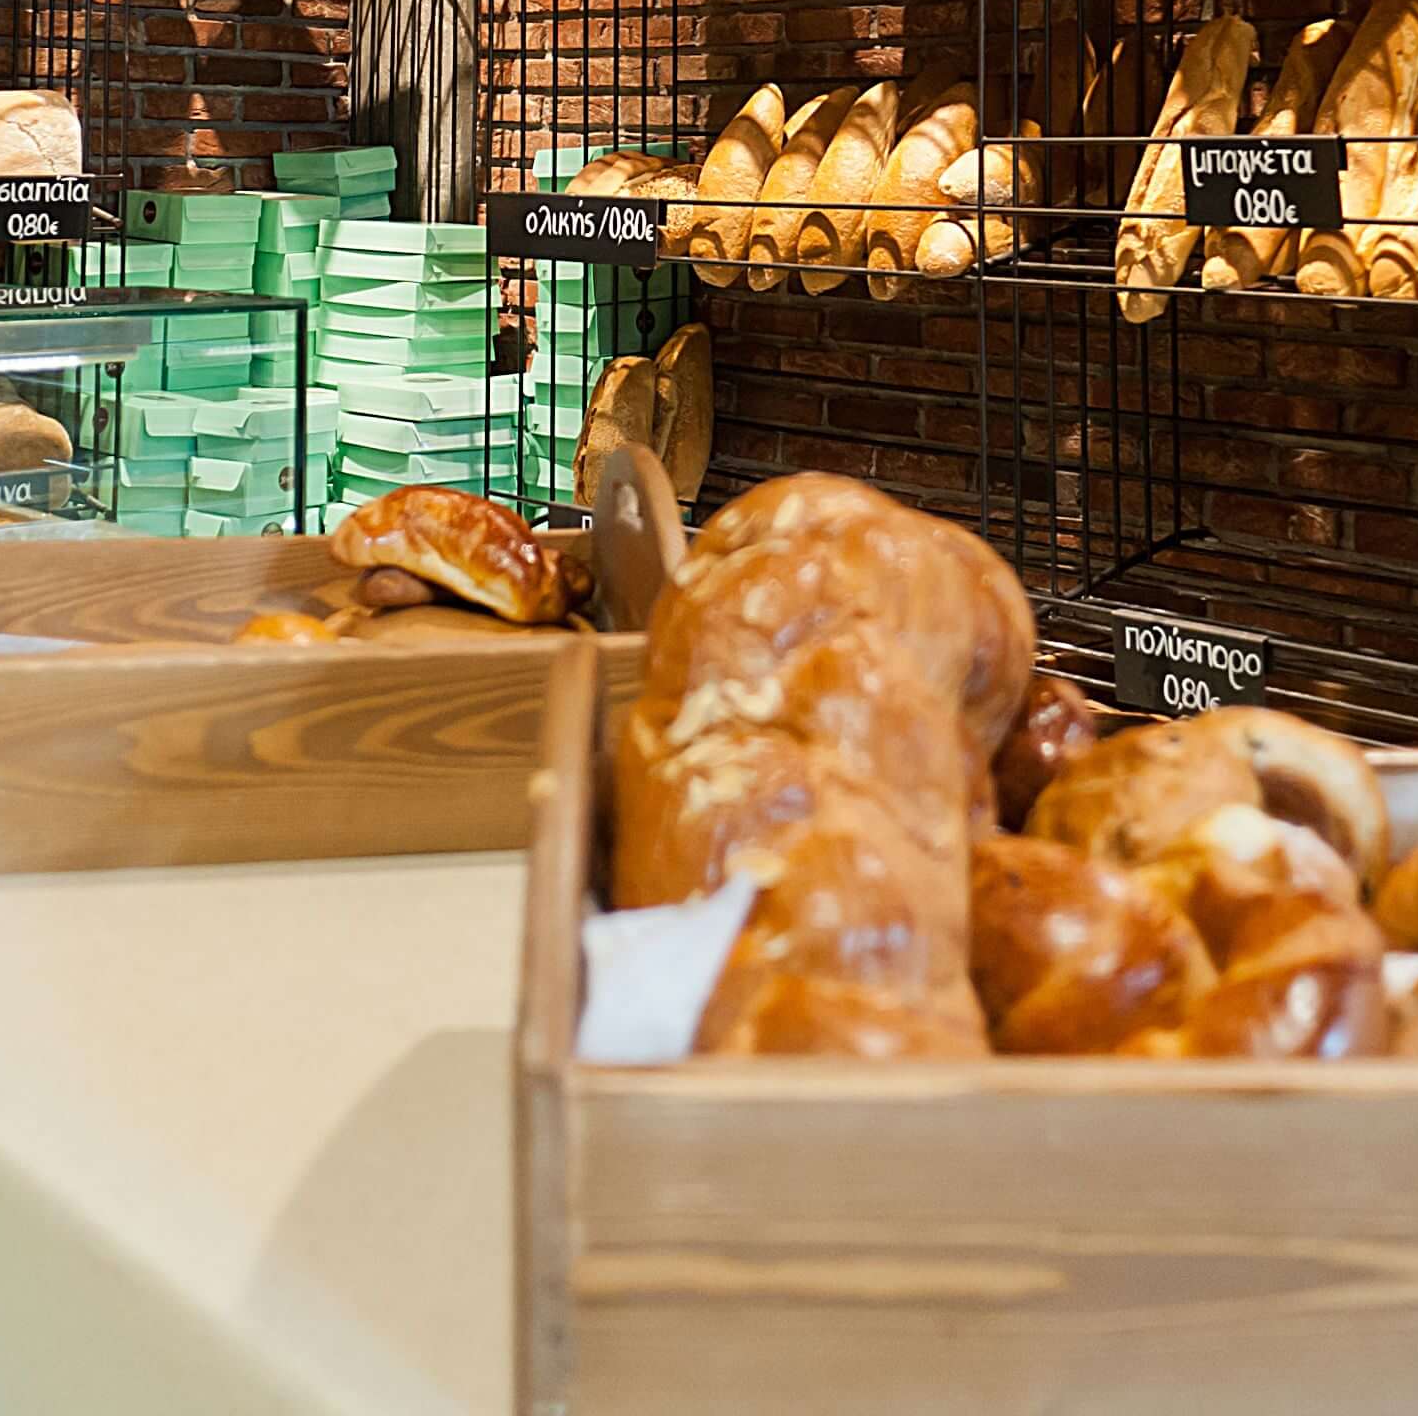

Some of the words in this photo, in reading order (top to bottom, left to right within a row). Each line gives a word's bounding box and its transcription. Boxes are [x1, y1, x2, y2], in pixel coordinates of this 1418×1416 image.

[1190, 139, 1318, 188] μπαγκέτα
[7, 212, 60, 240] 0,80€
[525, 199, 596, 239] ολικής
[1234, 187, 1300, 225] 0,80€
[1124, 625, 1262, 691] πολύσπορο
